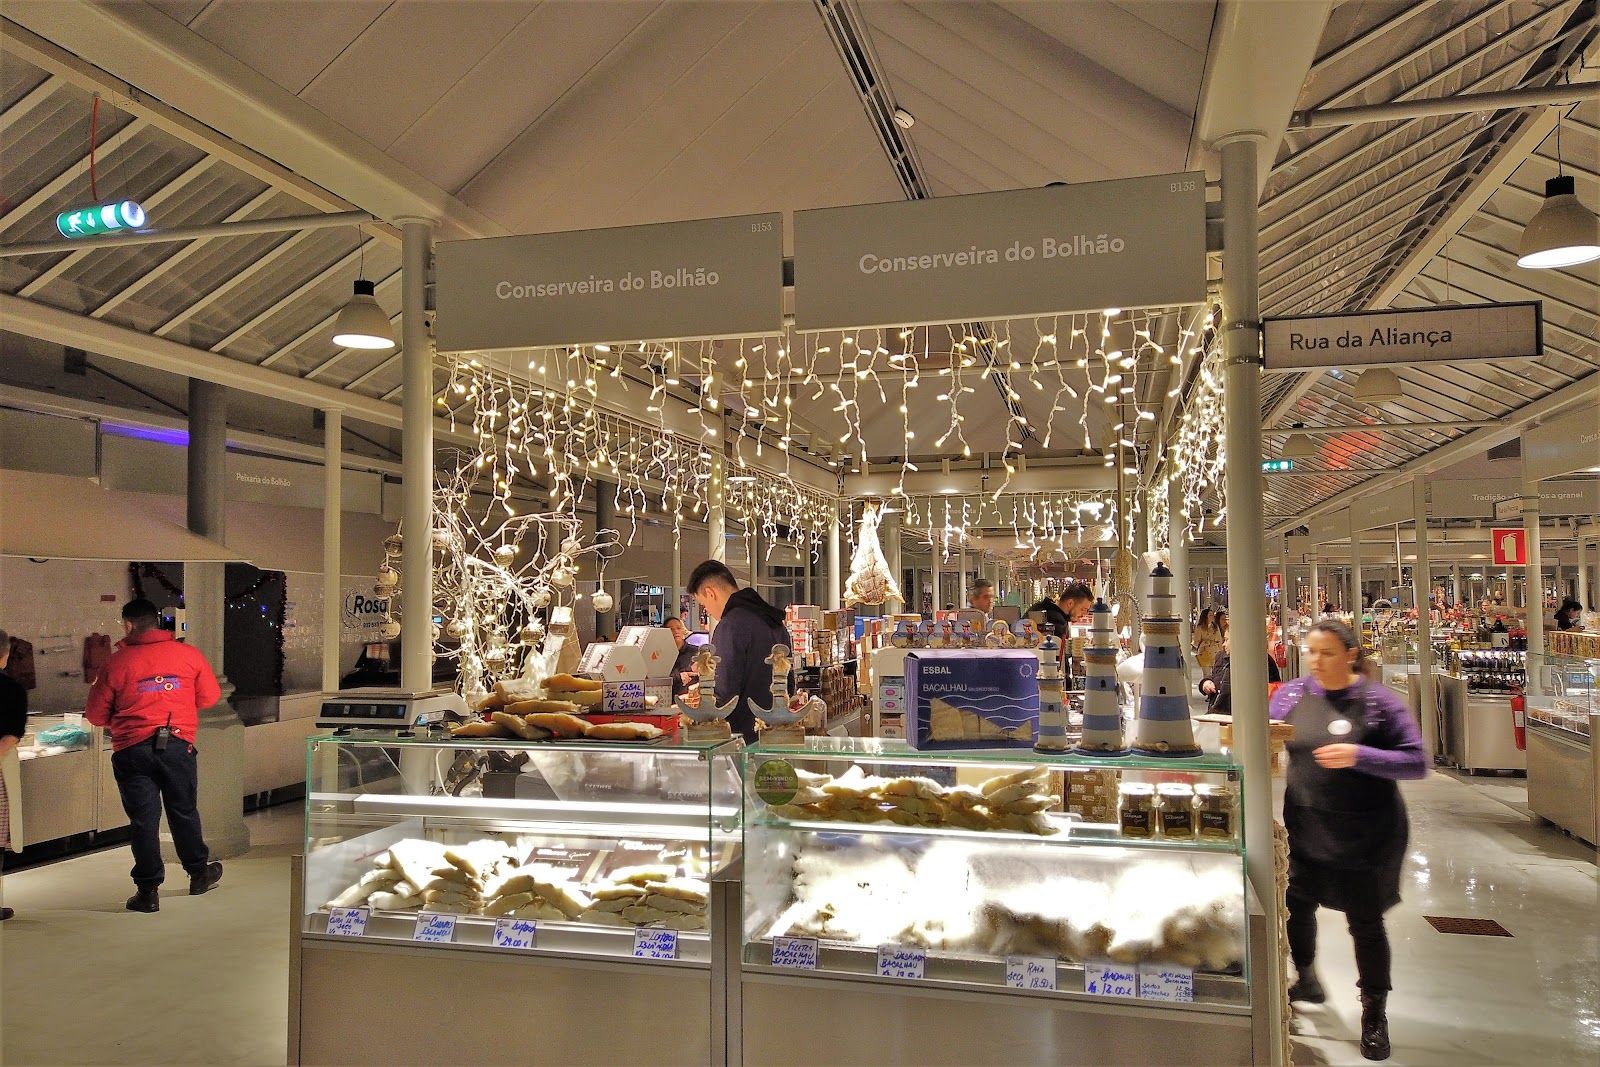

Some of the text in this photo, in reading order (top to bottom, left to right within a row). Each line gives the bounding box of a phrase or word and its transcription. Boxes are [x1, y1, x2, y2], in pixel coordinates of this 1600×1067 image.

[1170, 181, 1195, 192] B138
[751, 221, 772, 232] B153
[859, 234, 1125, 274] Conserveira do Bolhão
[496, 267, 720, 299] Conserveira do Bolhão
[1290, 328, 1452, 350] Rua da Aliança
[1472, 493, 1505, 501] Tradição
[1558, 491, 1583, 500] granel
[923, 666, 952, 674] ESBAL
[923, 683, 967, 692] BACALHAU
